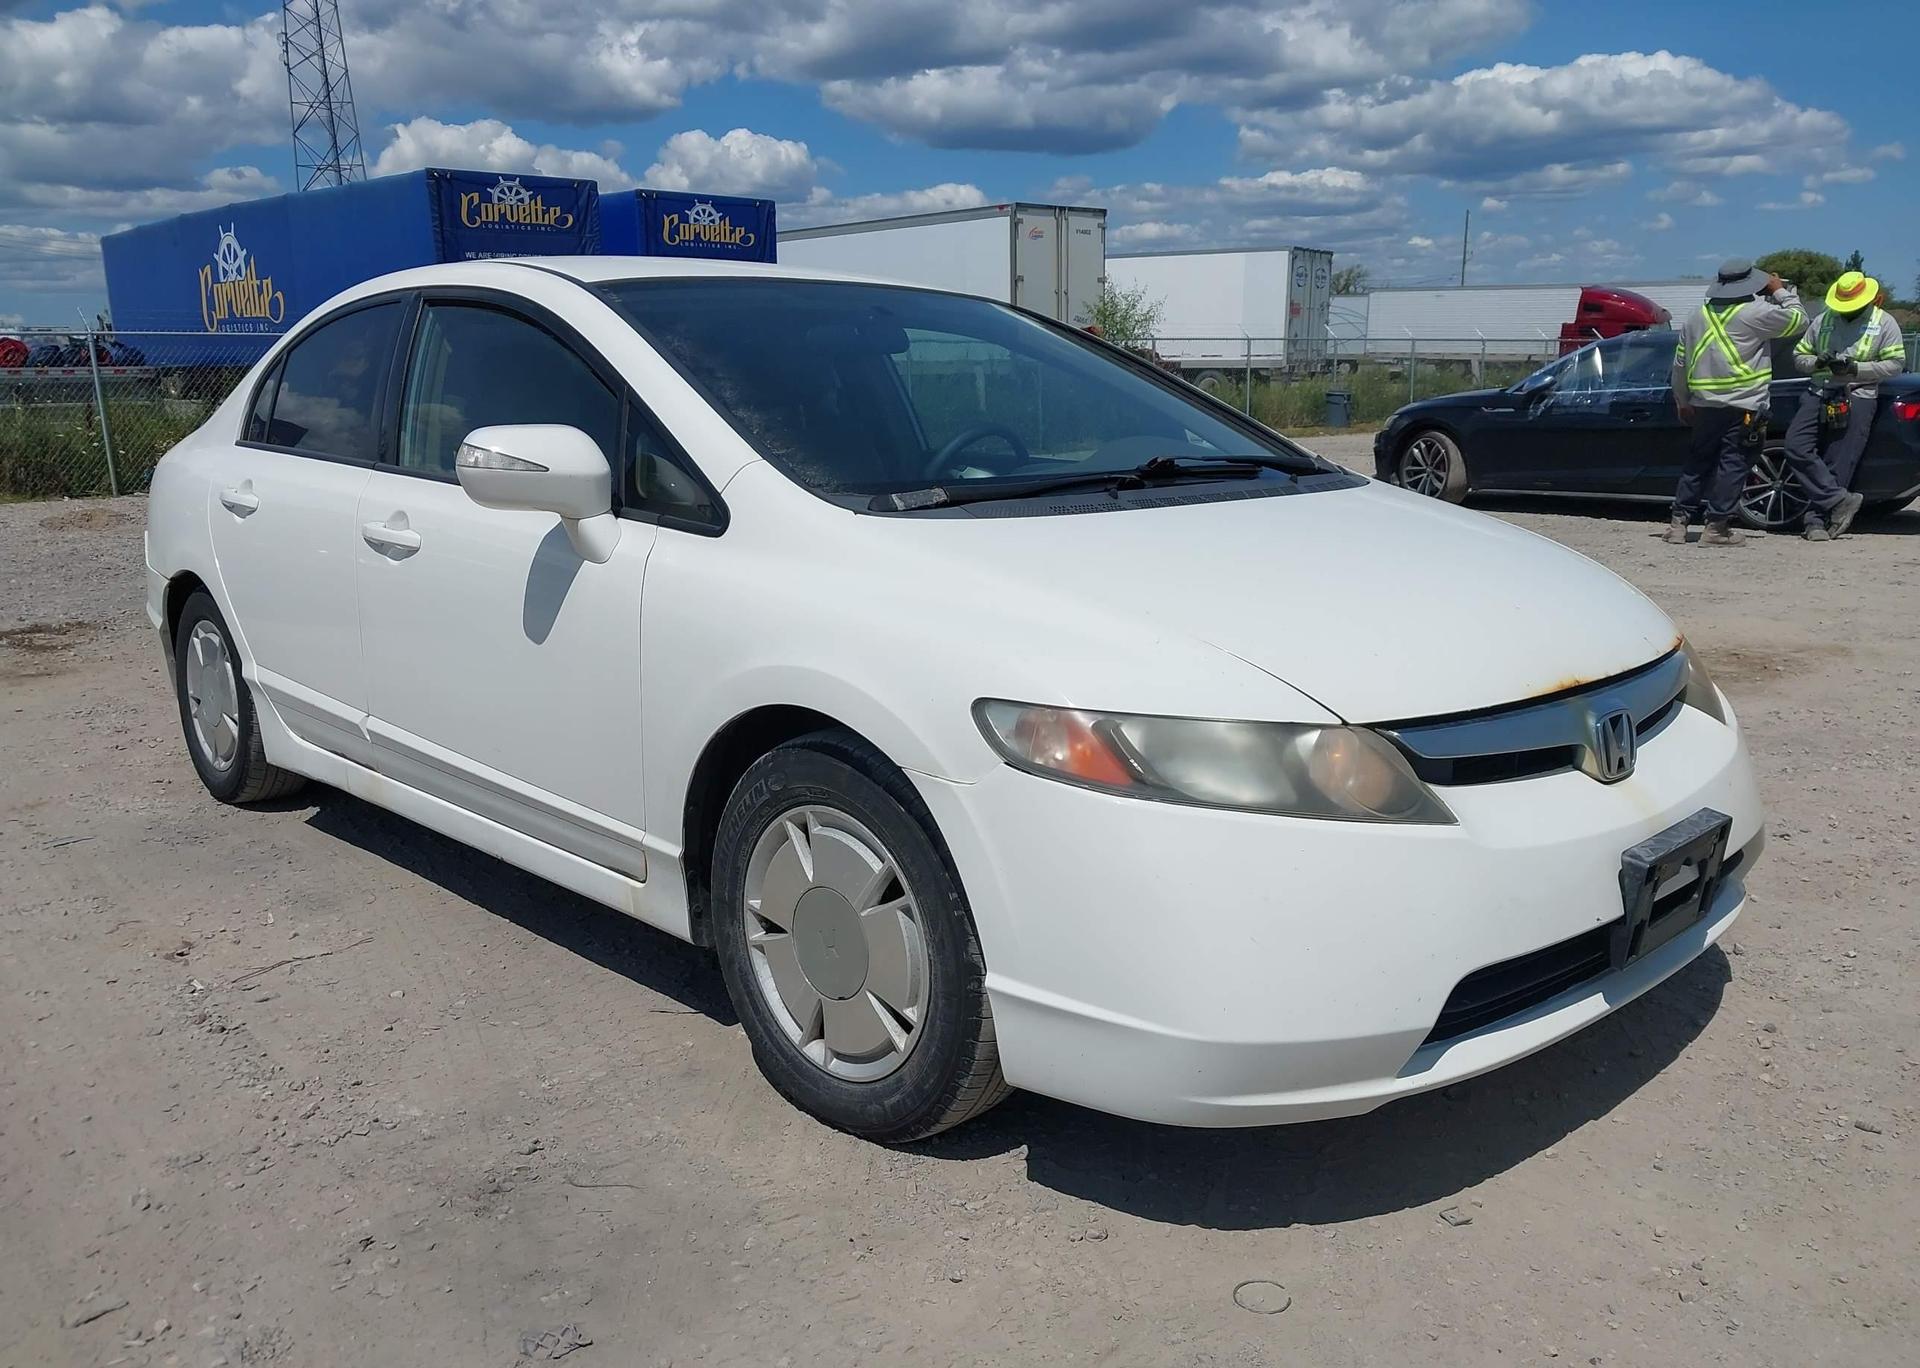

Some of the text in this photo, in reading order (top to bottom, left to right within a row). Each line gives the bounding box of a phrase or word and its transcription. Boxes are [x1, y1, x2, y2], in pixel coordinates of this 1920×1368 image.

[460, 192, 574, 229] Corvette
[482, 223, 532, 231] LOGISTICS
[662, 212, 756, 247] Corvette
[680, 241, 720, 249] LOGISTICS
[465, 251, 477, 259] WE
[478, 251, 492, 259] ARE
[199, 254, 285, 332] Corvette
[218, 323, 253, 332] LOGISTICS
